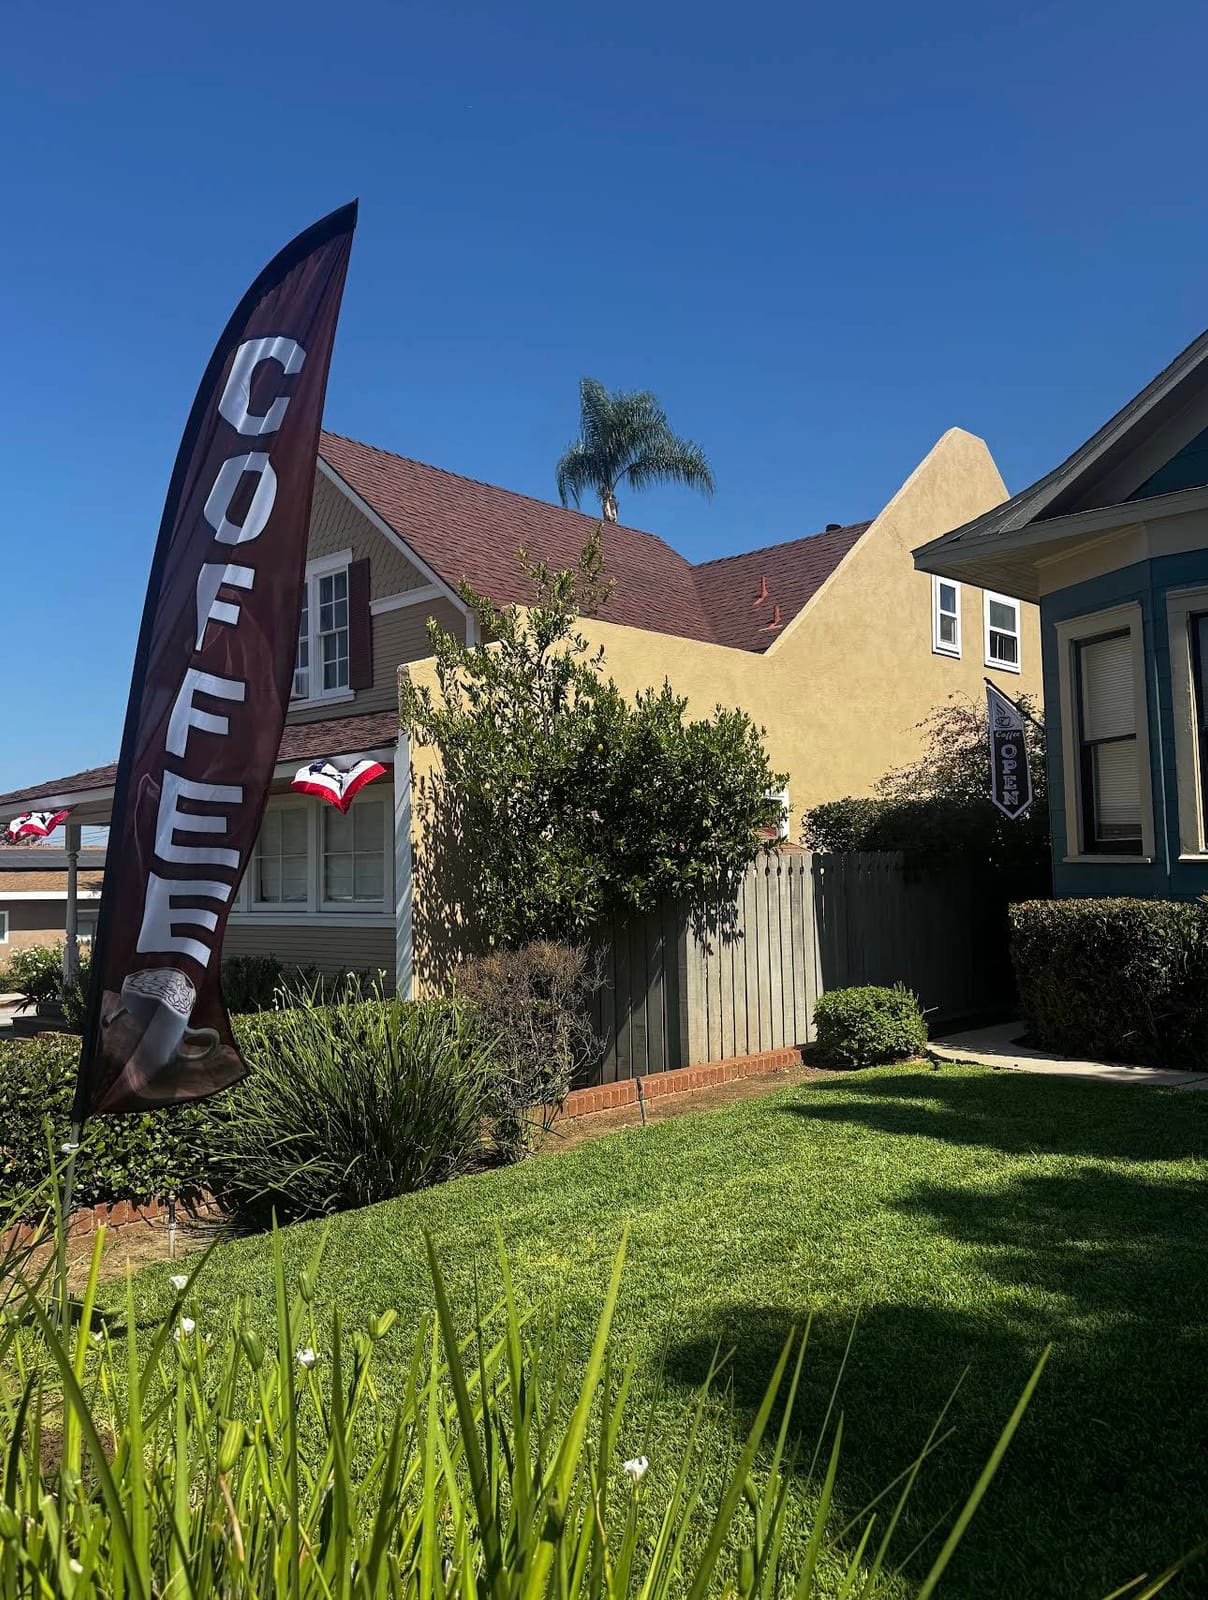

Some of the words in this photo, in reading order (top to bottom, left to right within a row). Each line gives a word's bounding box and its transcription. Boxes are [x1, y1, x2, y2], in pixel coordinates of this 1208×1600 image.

[136, 336, 307, 968] COFFEE
[995, 730, 1020, 740] Coffee
[1000, 744, 1019, 805] OPEN
